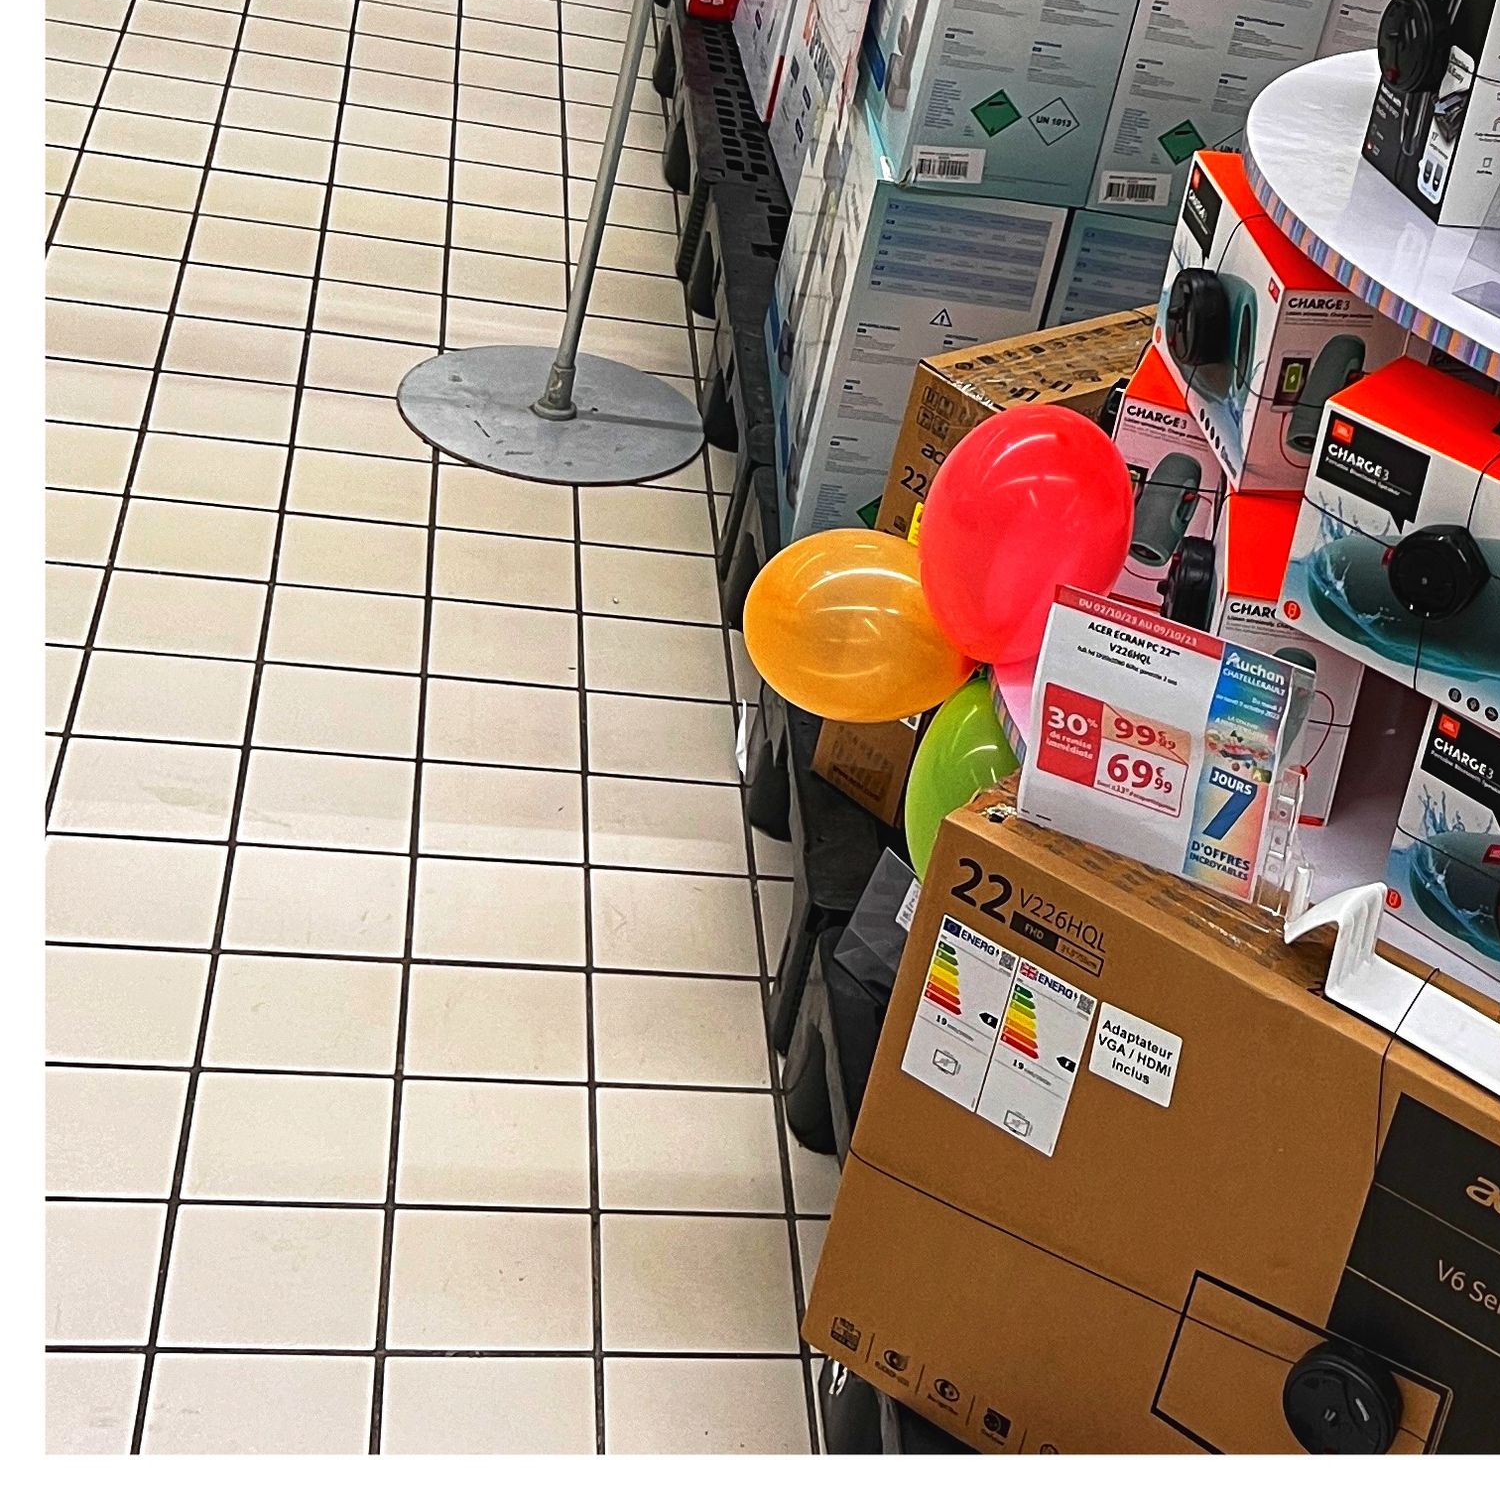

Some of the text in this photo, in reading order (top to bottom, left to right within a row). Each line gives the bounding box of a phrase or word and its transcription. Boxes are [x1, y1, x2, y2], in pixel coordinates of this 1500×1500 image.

[1087, 622, 1159, 652] ACER ECRAN PC
[1109, 642, 1151, 666] V226HQL
[1225, 651, 1286, 685] Auchan
[1113, 717, 1156, 746] 99
[1107, 753, 1153, 788] 69
[1211, 771, 1253, 795] JOURS
[1191, 839, 1250, 871] D'OFFRES
[951, 857, 1106, 953] 22 V226HQL
[960, 929, 996, 956] ENERG
[1038, 972, 1075, 1001] ENERG
[1102, 1018, 1173, 1060] Adaptateur
[1098, 1033, 1172, 1078] VGA HDMI
[1111, 1056, 1150, 1085] inclus
[1436, 1256, 1466, 1294] V6
